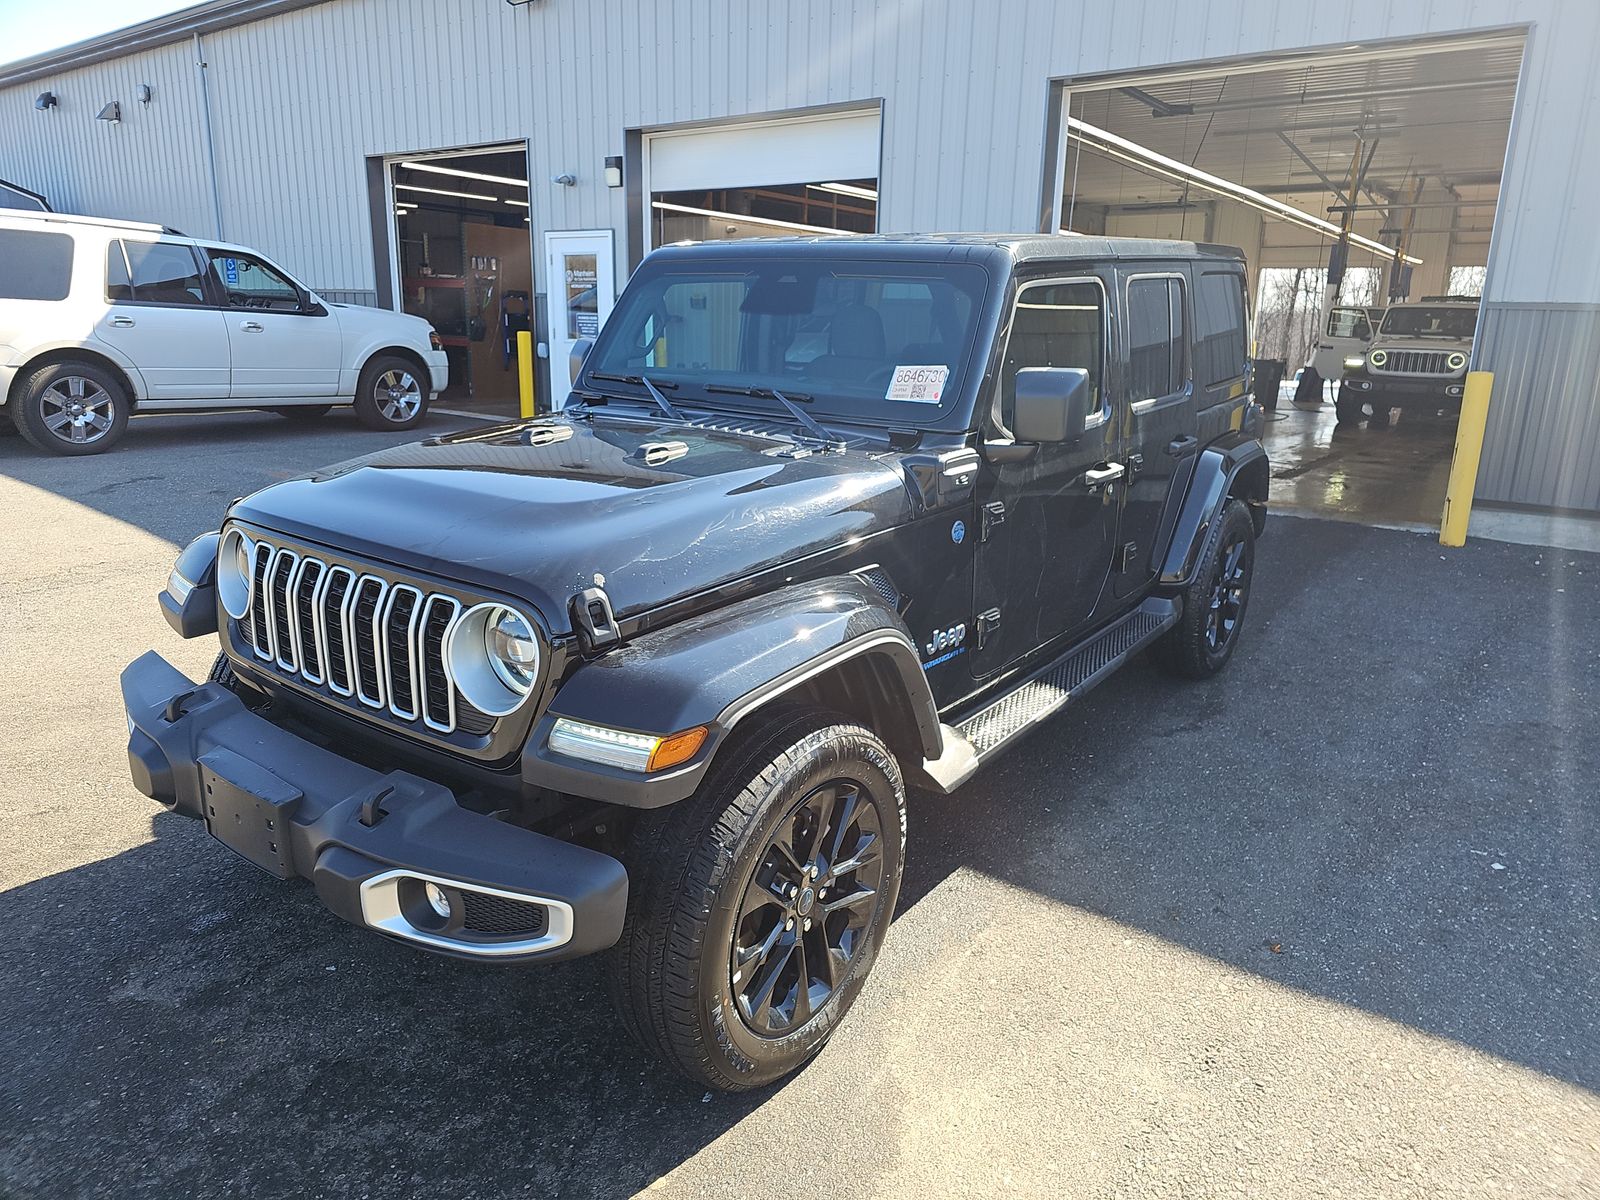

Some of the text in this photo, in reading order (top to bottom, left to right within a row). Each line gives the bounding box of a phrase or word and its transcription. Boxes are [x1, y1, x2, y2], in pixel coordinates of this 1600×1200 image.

[896, 369, 946, 383] 8646730
[926, 623, 966, 656] Jeep
[711, 1003, 751, 1073] NEXEN
